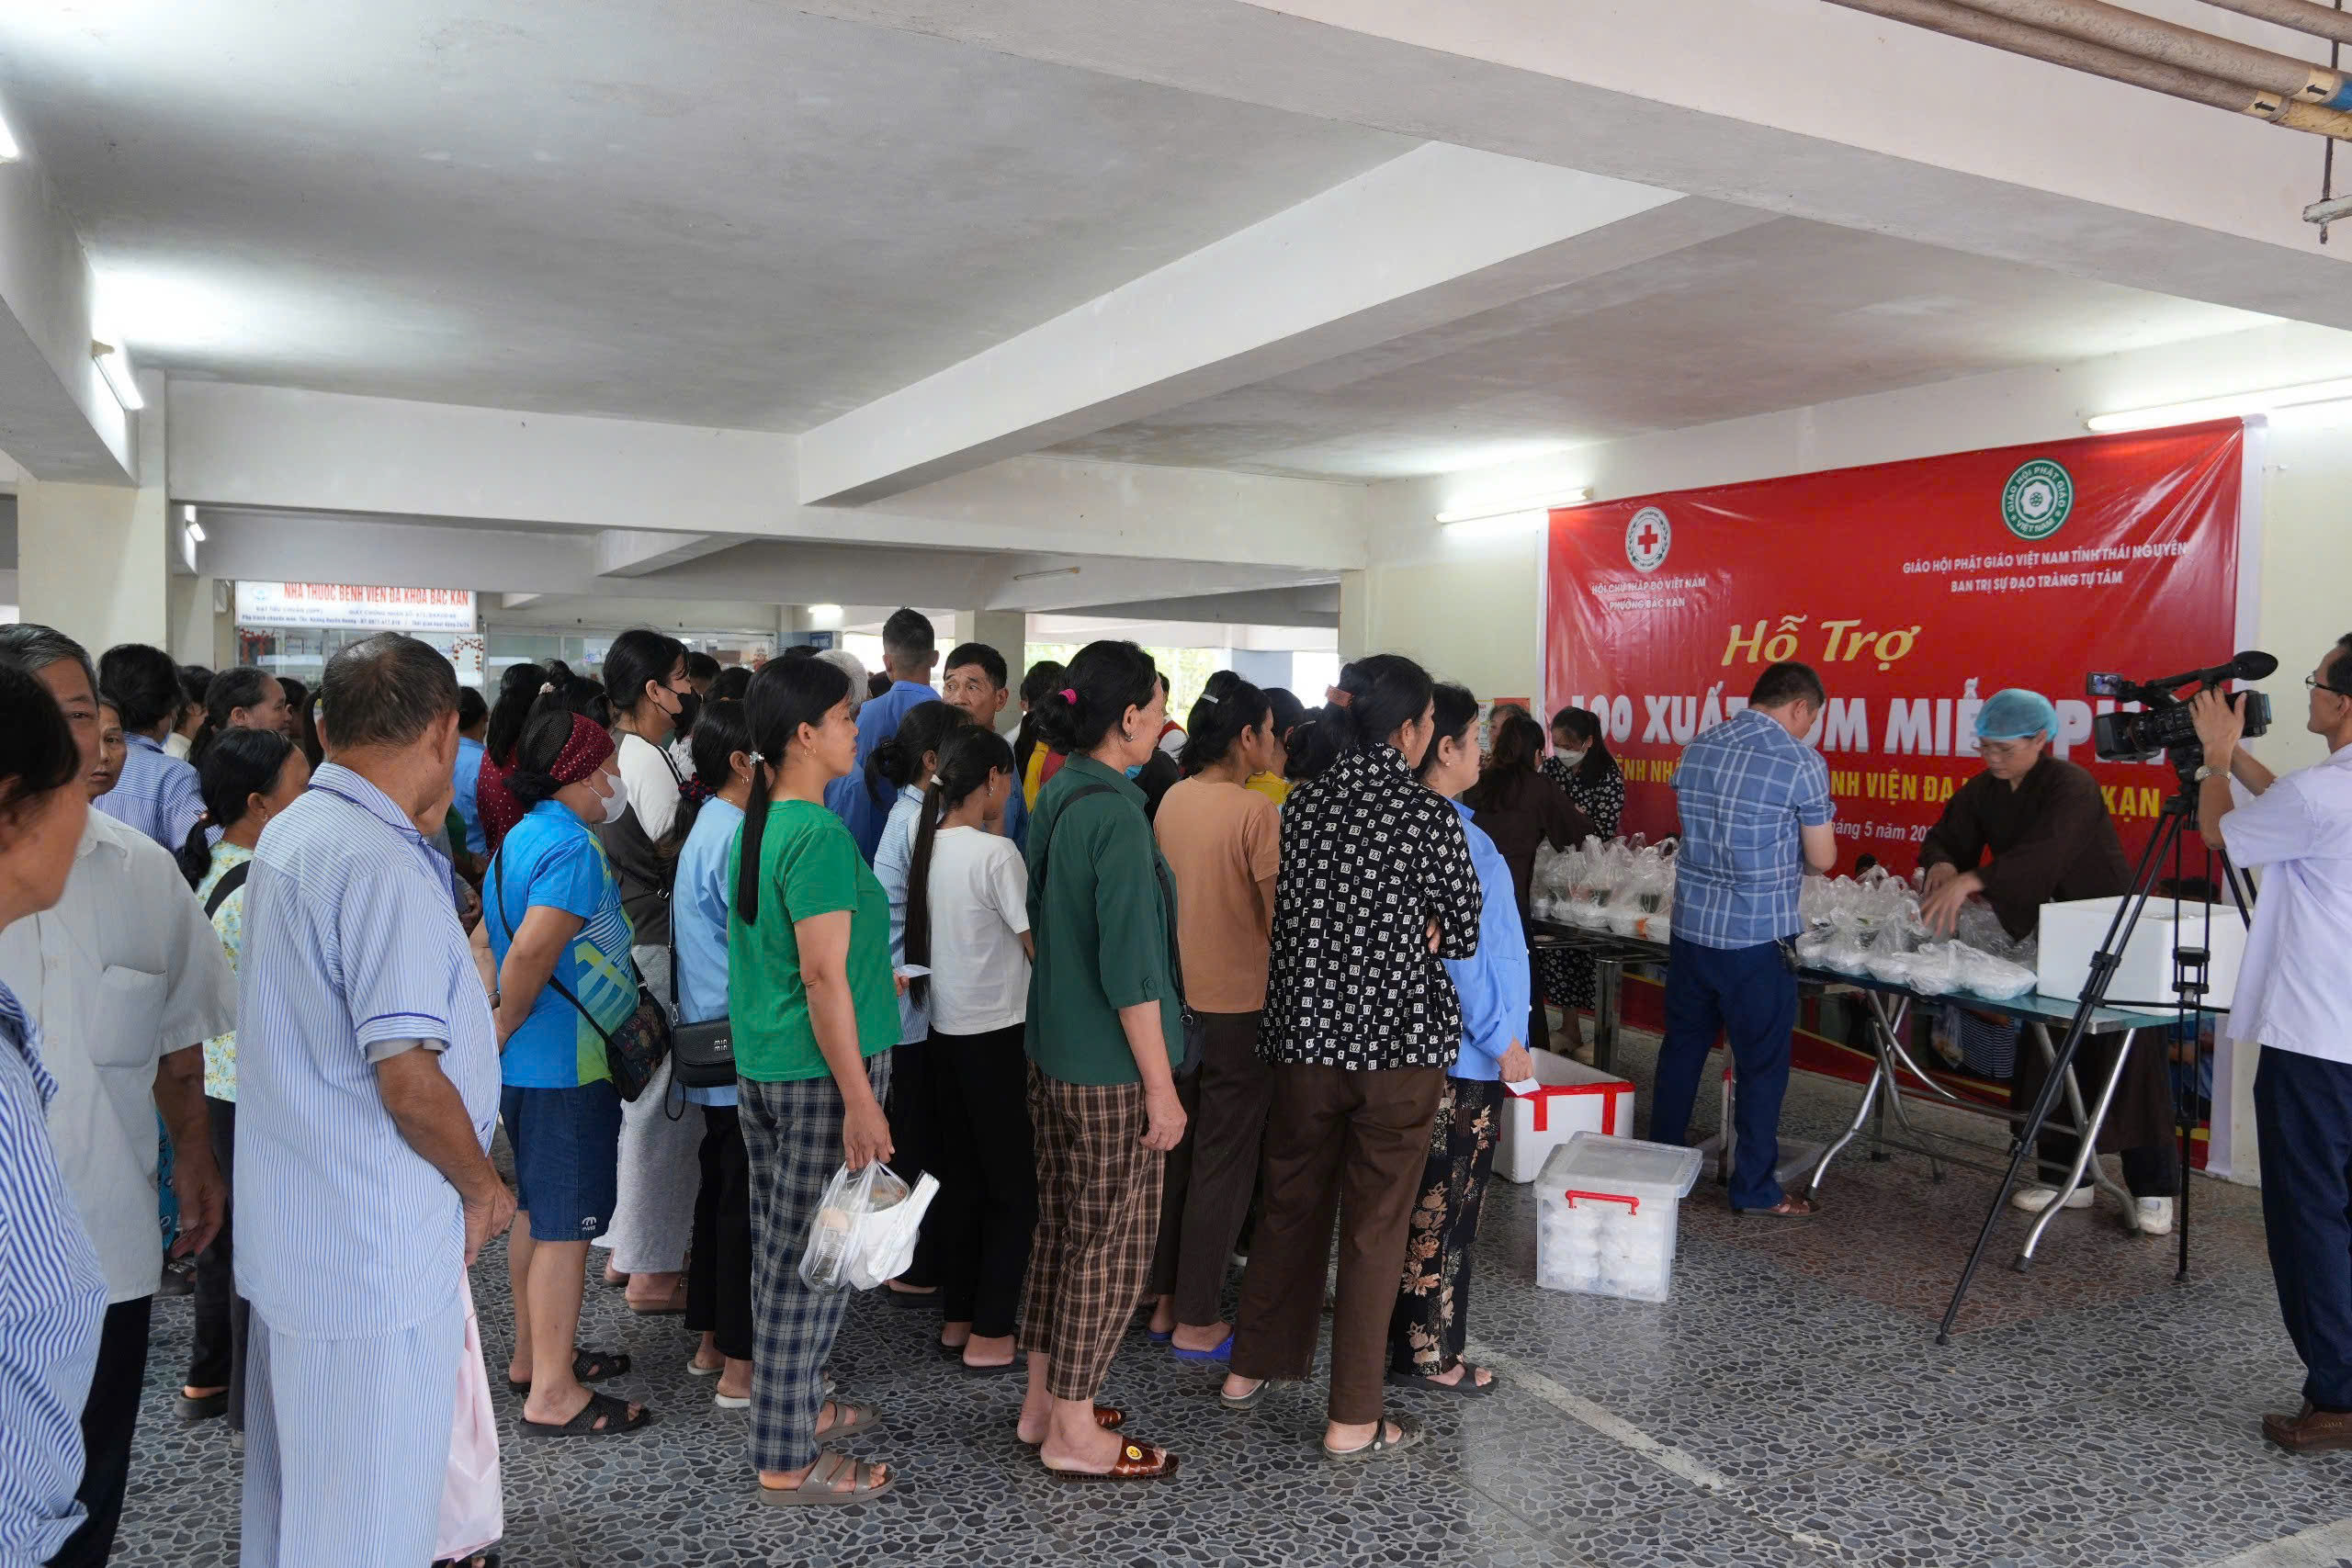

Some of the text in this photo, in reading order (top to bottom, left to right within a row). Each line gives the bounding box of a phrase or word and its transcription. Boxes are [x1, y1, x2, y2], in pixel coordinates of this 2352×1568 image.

[1903, 539, 2187, 574] GIÁO HỘI PHẬT GIÁO VIỆT NAM TỈNH THÁI NGUYÊN
[1685, 577, 1706, 588] NAM
[1951, 568, 2124, 594] BAN TRỊ SỰ ĐẠO TRÀNG TỰ TÂM
[1721, 614, 1922, 671] Hỗ Trợ
[1866, 768, 1917, 806] VIỆN
[1923, 775, 1955, 803] ĐA
[2101, 785, 2160, 822] KẠN
[1864, 820, 1873, 837] 5
[1875, 822, 1905, 840] năm
